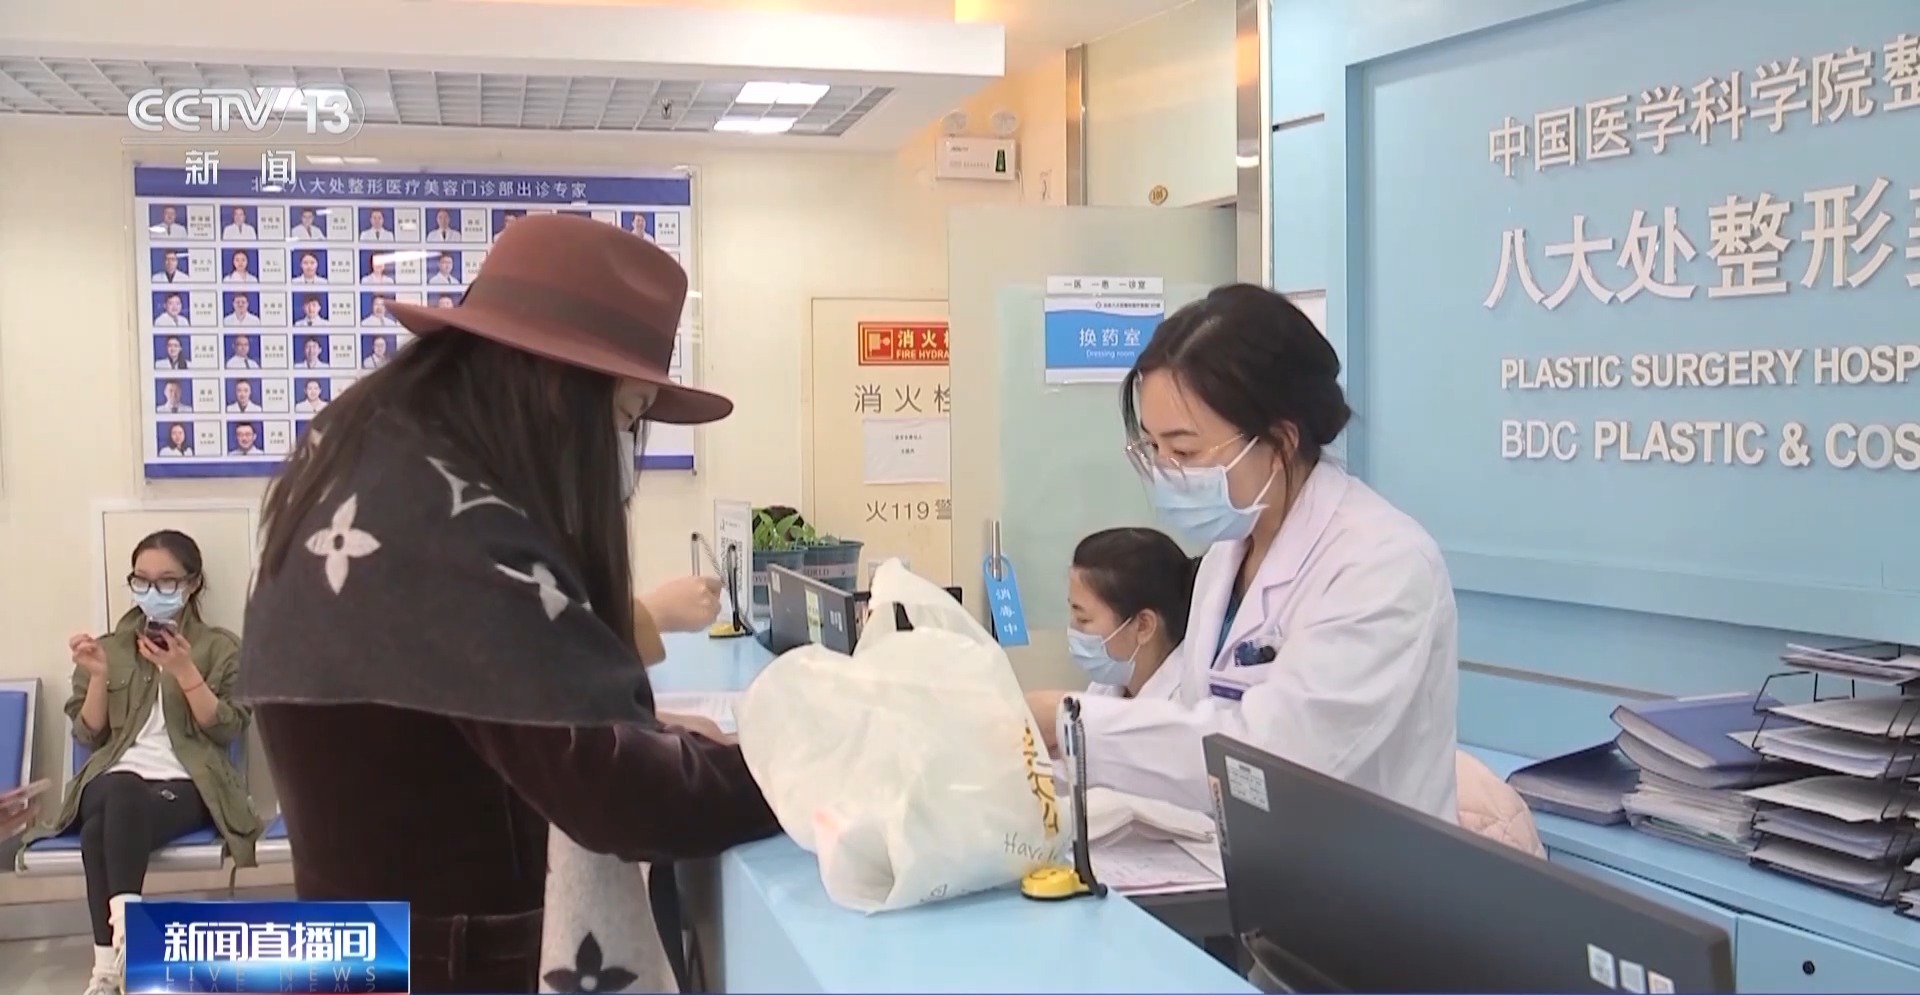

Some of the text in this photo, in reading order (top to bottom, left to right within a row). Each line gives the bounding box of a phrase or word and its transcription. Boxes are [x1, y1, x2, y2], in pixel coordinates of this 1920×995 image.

[1482, 176, 1920, 311] 八大处整形
[895, 348, 917, 360] FIRE
[1078, 327, 1141, 348] 换药室
[1500, 343, 1920, 390] PLASTIC SURGERY HOSP
[1500, 418, 1920, 472] BDC PLASTIC & COS
